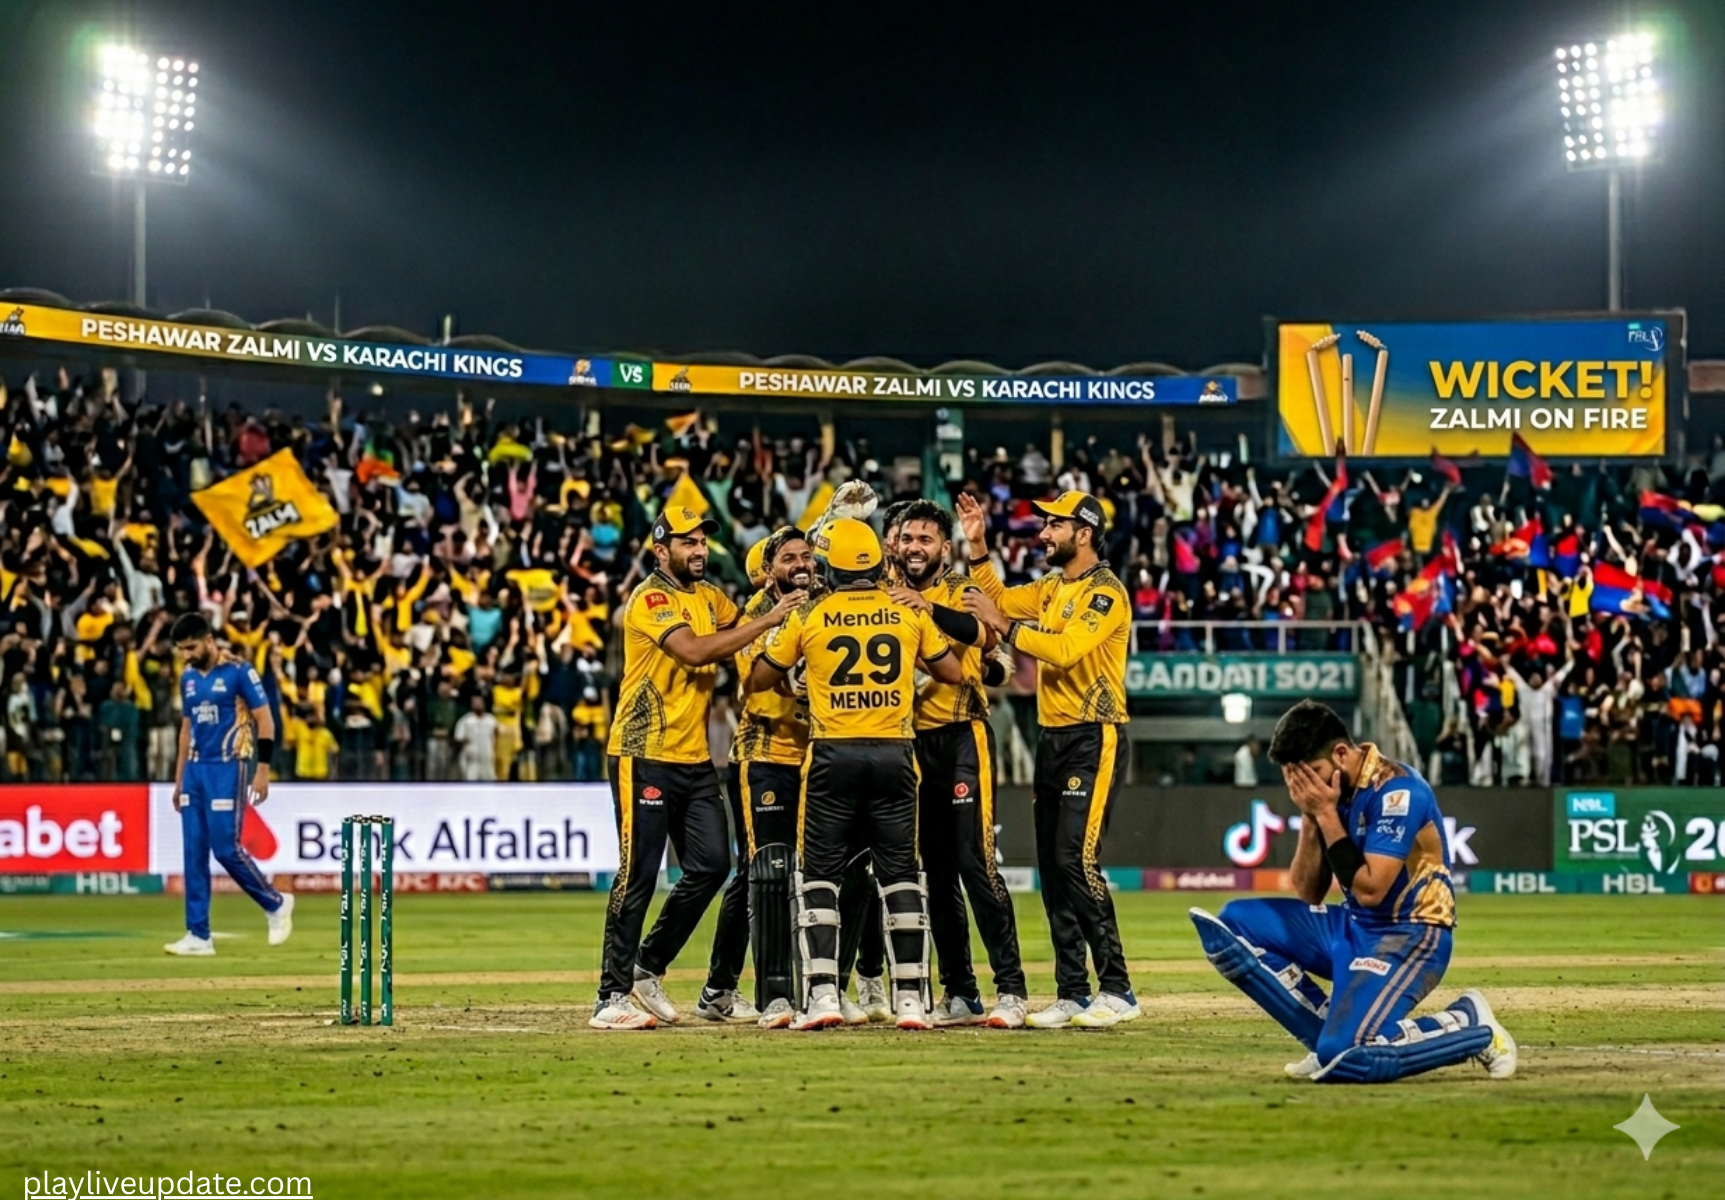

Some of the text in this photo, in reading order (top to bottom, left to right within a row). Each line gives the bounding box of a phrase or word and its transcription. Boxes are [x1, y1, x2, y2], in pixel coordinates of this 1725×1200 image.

[81, 318, 523, 378] PESHAWAR ZALMI VS KARACHI KINGS
[619, 362, 644, 383] VS
[739, 371, 1155, 400] PESHAWAR ZALMI VS KARACHI KINGS
[1429, 360, 1653, 399] WICKET!
[1430, 408, 1648, 429] ZALMI ON FIRE
[823, 608, 901, 628] Mendis
[826, 633, 901, 687] 29
[428, 817, 589, 860] Alfalah
[1568, 819, 1641, 853] PSL
[1494, 872, 1557, 894] HBL
[1602, 873, 1666, 894] HBL
